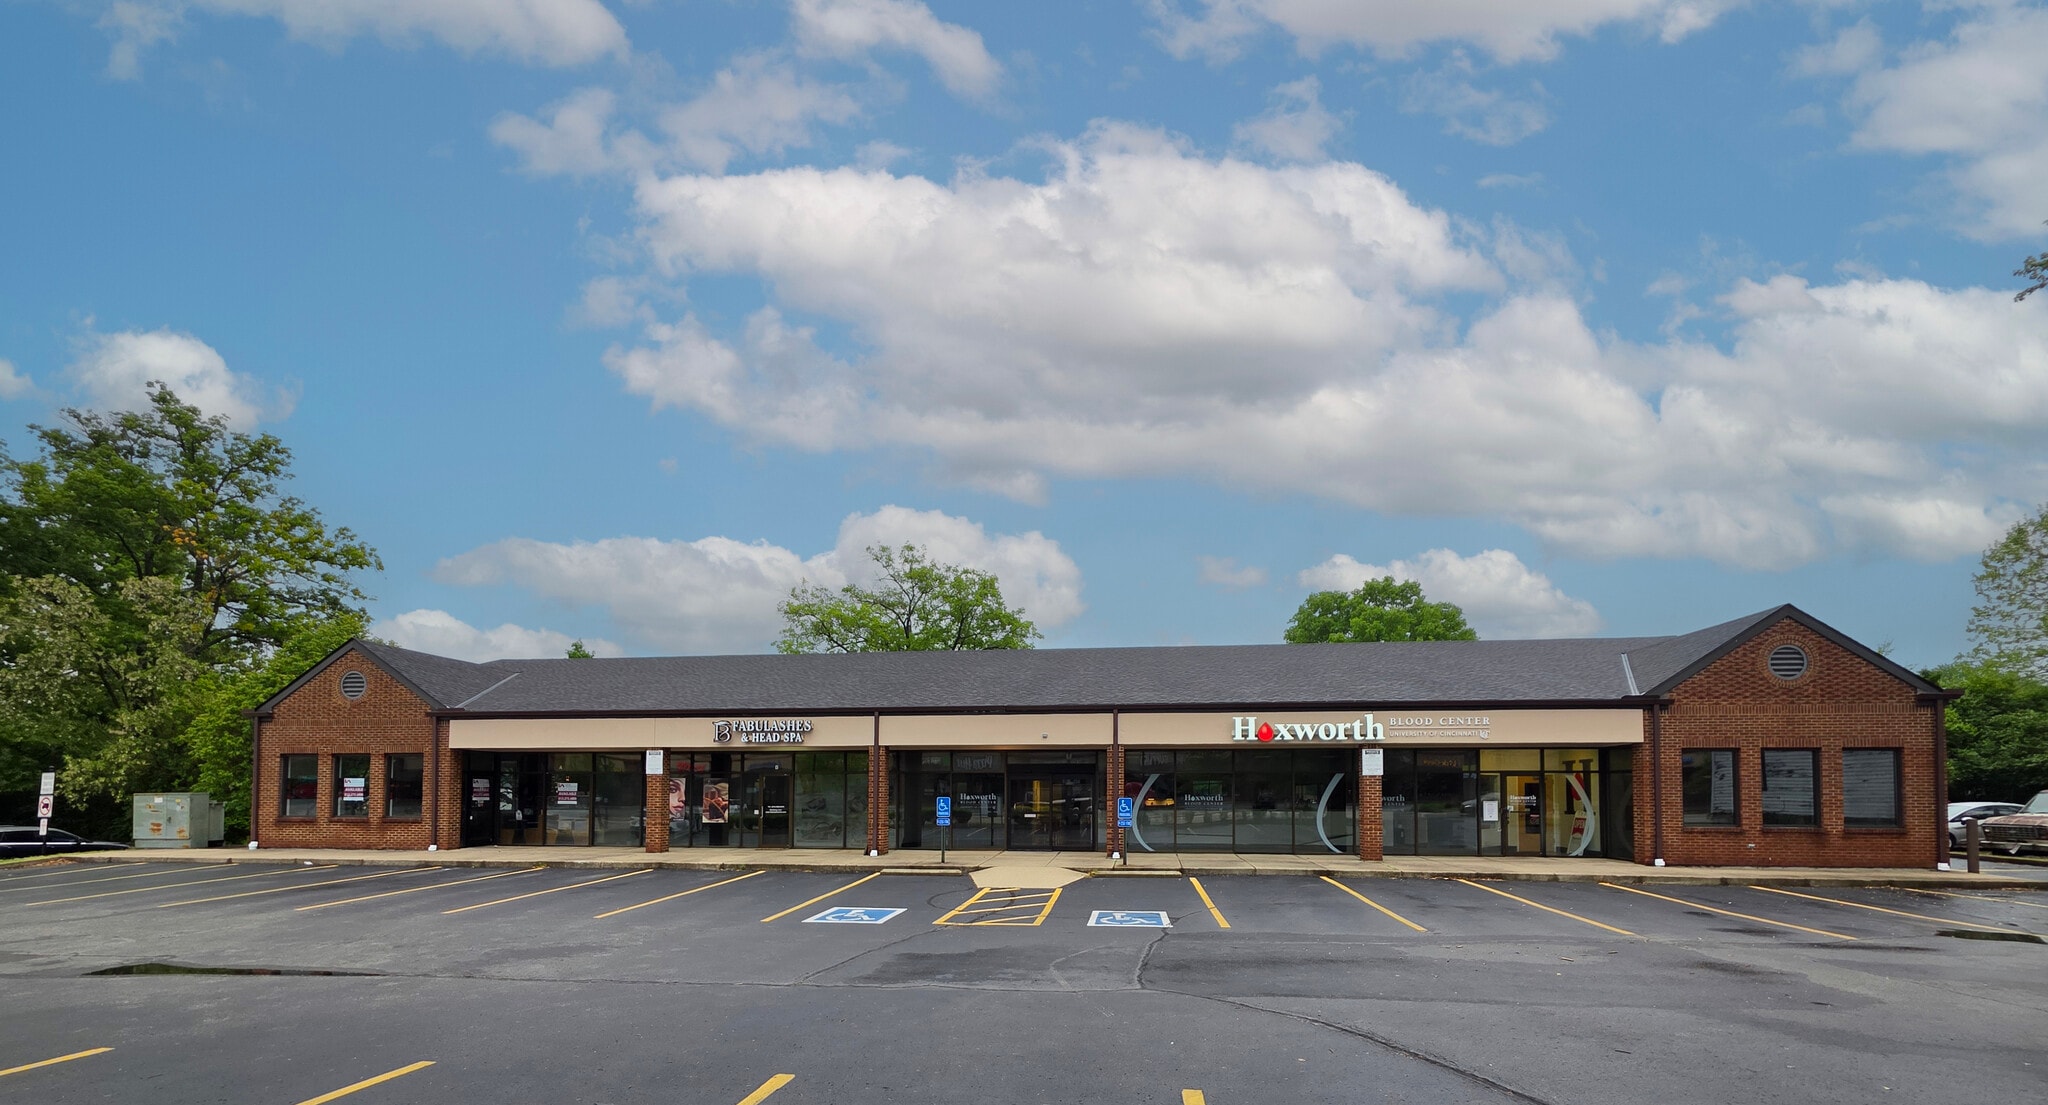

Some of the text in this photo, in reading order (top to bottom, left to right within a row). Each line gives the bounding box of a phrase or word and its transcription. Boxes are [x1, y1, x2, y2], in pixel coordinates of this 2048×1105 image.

[732, 719, 813, 732] FABULASHES
[1390, 716, 1491, 726] BLOOD CENTER
[1232, 713, 1386, 742] Hoxworth
[741, 732, 803, 743] & HEAD SPA
